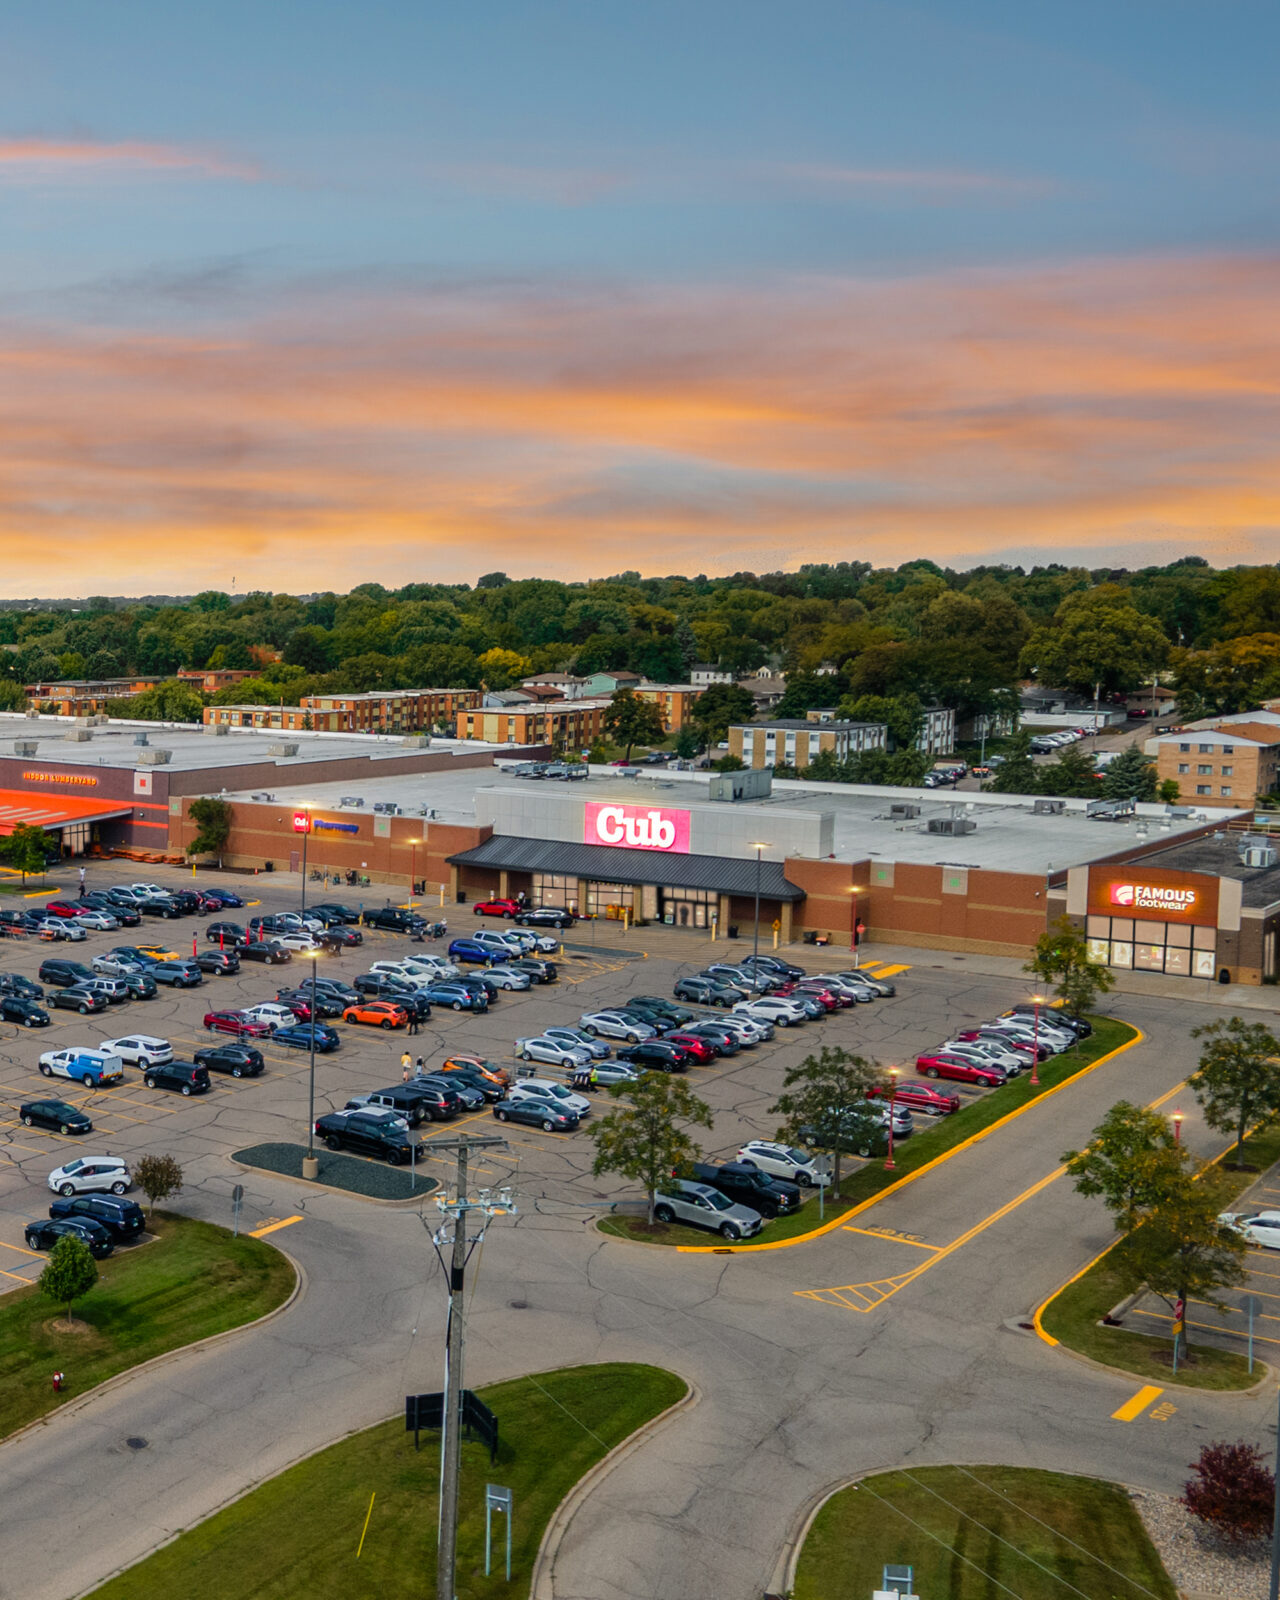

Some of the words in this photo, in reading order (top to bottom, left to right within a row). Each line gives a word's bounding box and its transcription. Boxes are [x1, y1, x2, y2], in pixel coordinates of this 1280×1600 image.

[596, 806, 675, 848] Cub
[1135, 886, 1195, 903] FAMOUS
[1135, 897, 1188, 911] footwear
